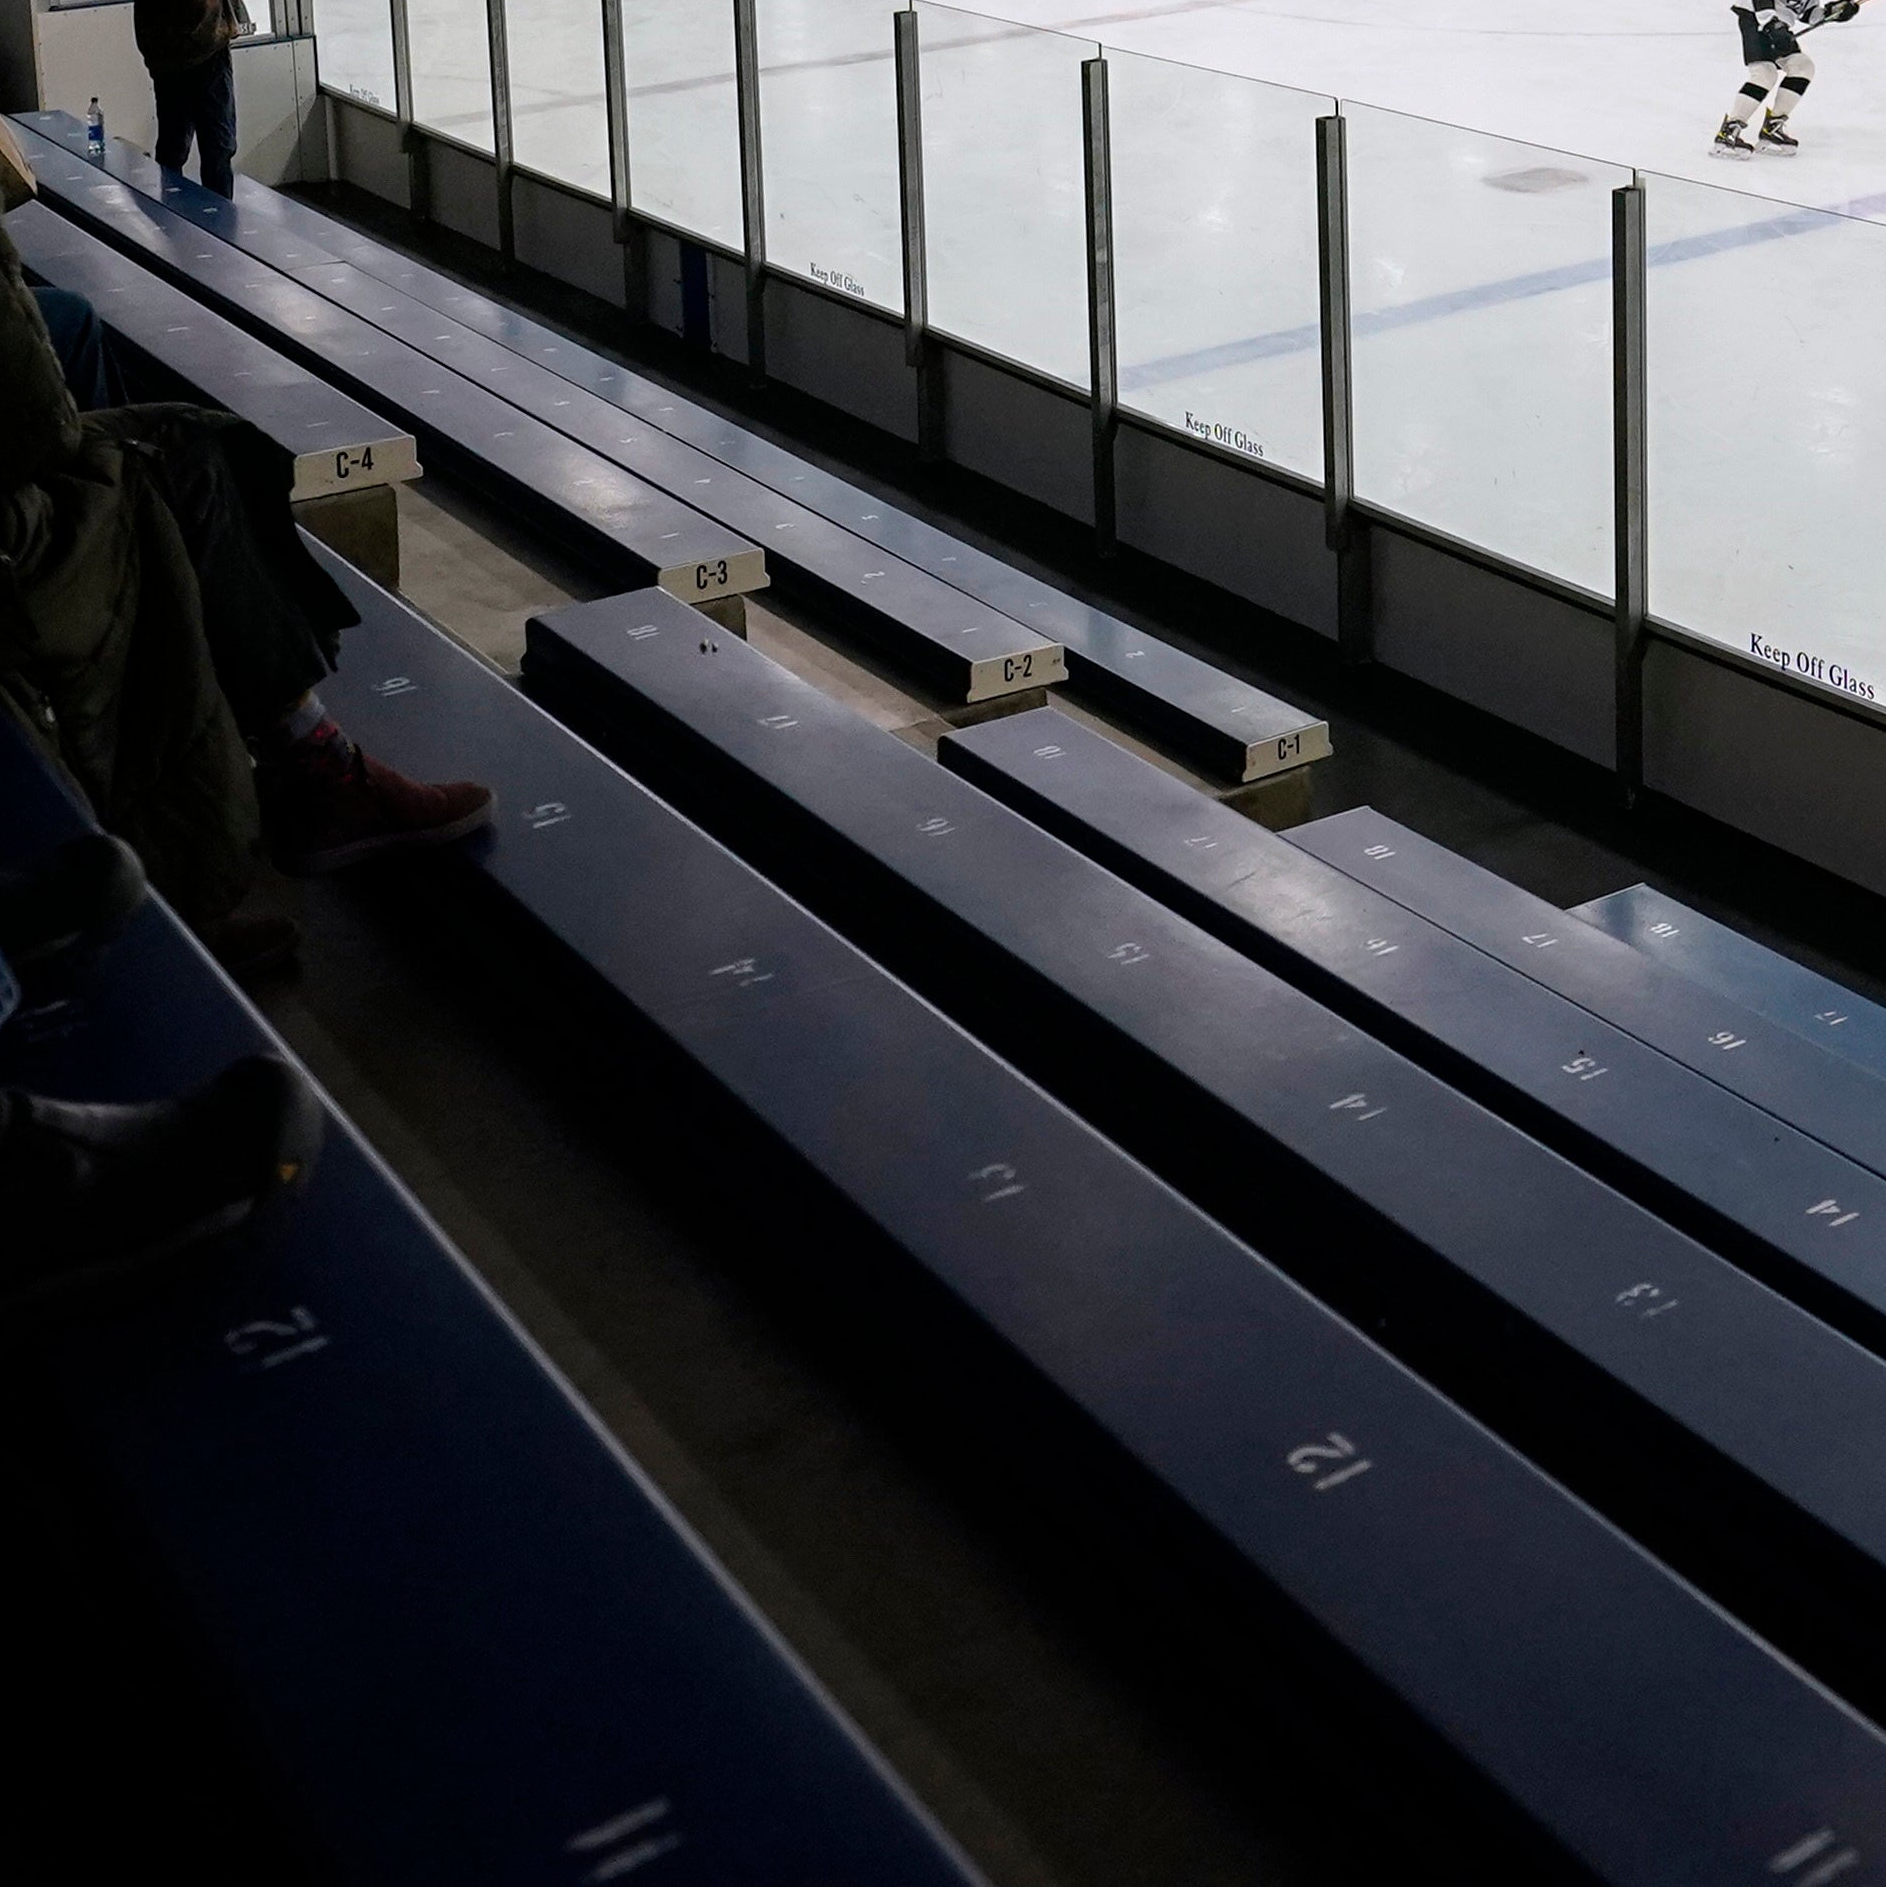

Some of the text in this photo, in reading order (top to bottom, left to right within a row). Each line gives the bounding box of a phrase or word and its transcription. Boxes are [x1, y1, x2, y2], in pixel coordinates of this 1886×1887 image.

[1185, 411, 1263, 457] Keep Off Glass
[335, 447, 374, 479] C-4
[695, 561, 728, 589] C-3
[1004, 655, 1032, 682] C-2
[1750, 633, 1875, 700] Keep Off Glass
[1277, 735, 1300, 759] C-1
[1708, 1031, 1746, 1050] 16
[1561, 1057, 1608, 1081] 15
[1806, 1199, 1859, 1227] 14
[223, 1304, 330, 1370] 12
[1287, 1432, 1371, 1490] 12
